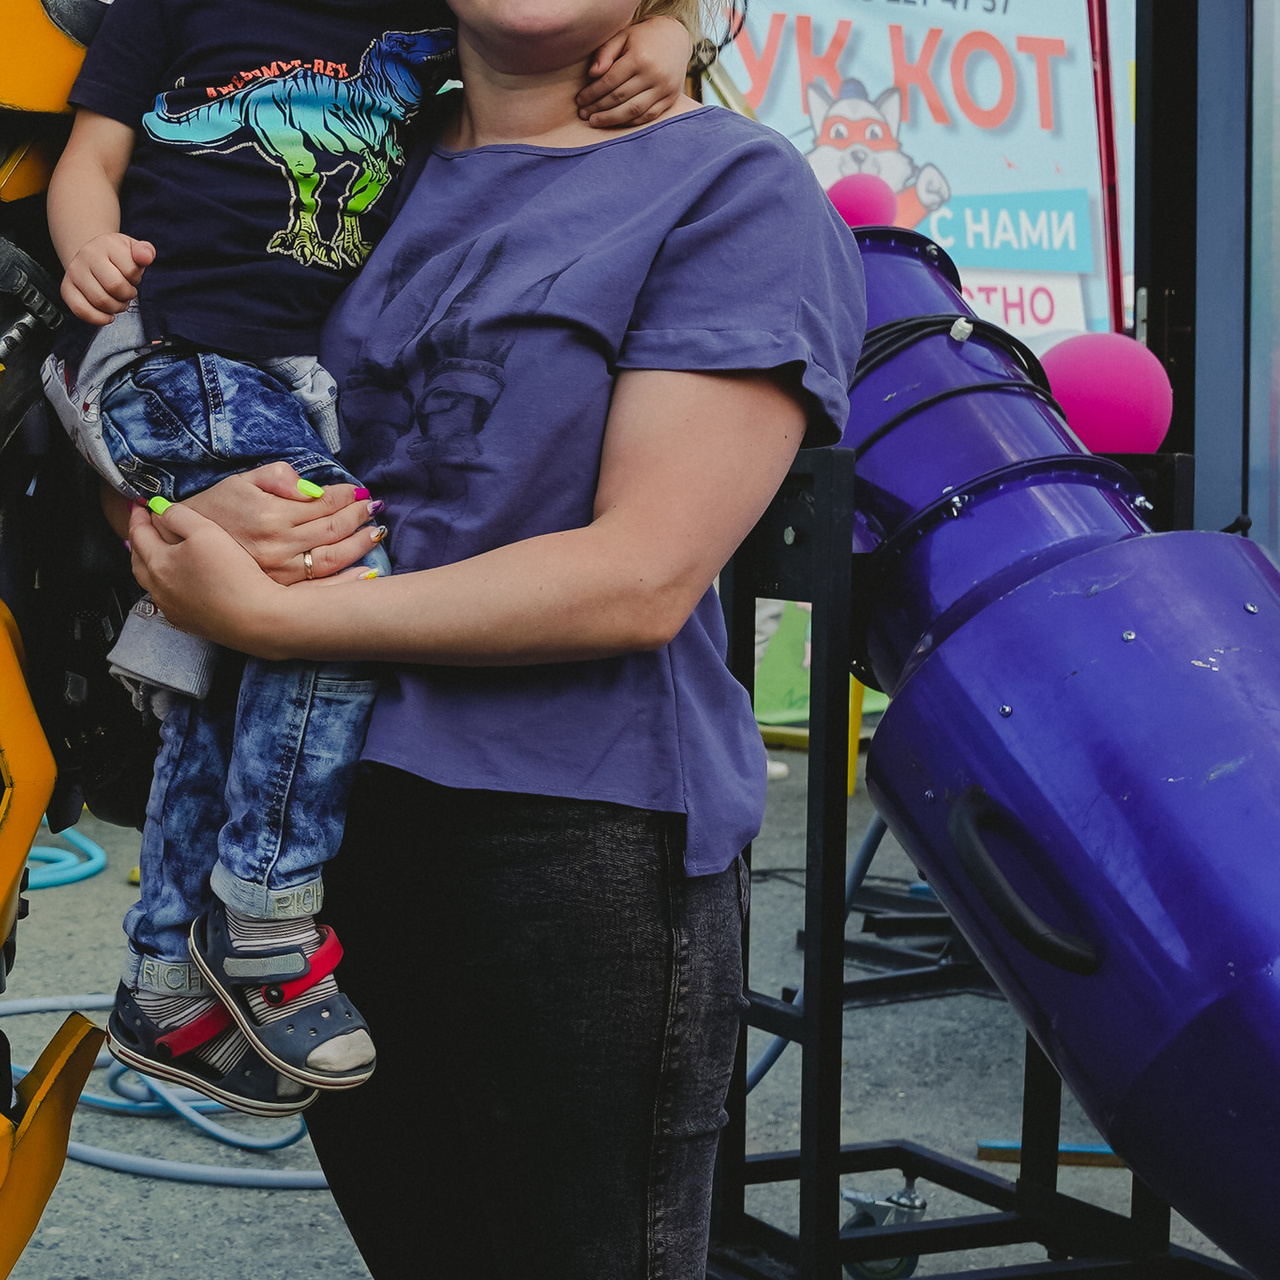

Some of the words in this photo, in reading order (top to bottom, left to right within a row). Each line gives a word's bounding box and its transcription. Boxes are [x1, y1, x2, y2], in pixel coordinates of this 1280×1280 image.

[887, 24, 1067, 131] КОТ
[929, 206, 956, 249] С
[964, 208, 1077, 251] НАМИ
[142, 960, 204, 992] RICH
